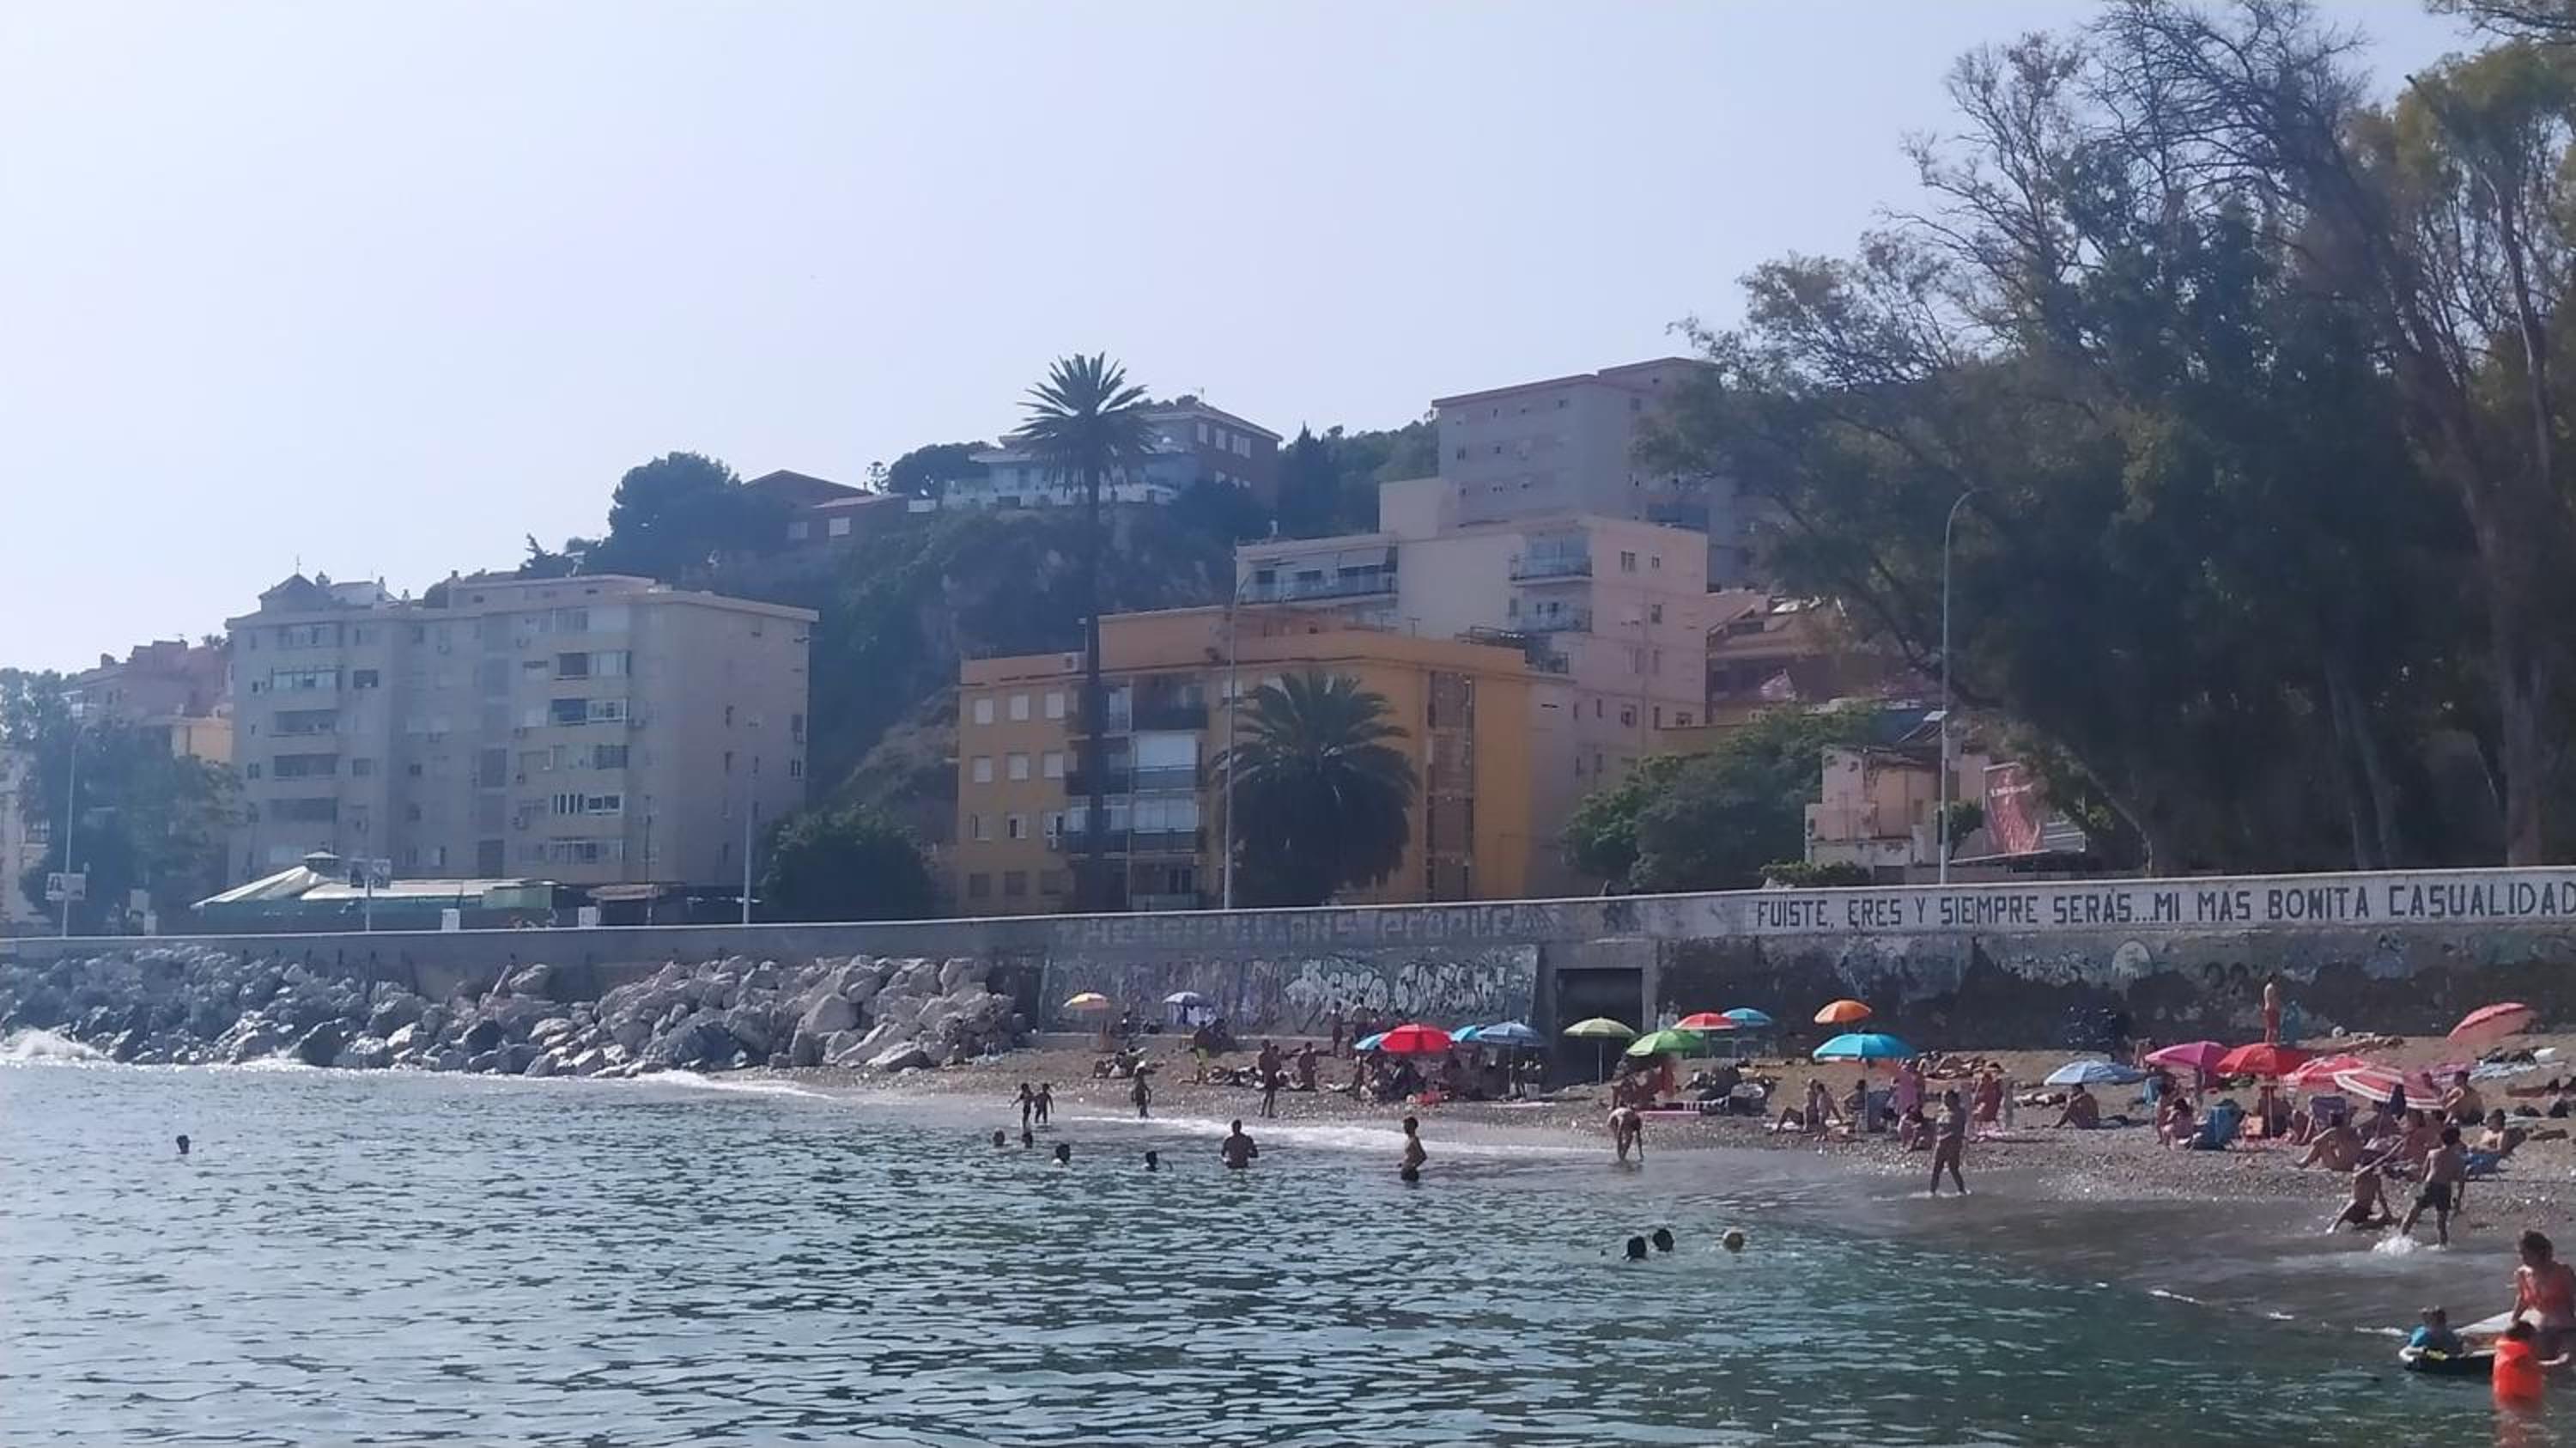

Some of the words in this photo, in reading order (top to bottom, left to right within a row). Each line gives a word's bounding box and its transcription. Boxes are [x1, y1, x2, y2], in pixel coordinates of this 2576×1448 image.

[1847, 897, 1903, 928] ERES
[1914, 896, 1927, 924] Y
[1940, 894, 2039, 925] SIEMPRE
[2267, 885, 2370, 921] BONITA
[2388, 880, 2576, 917] CASUALIDAD
